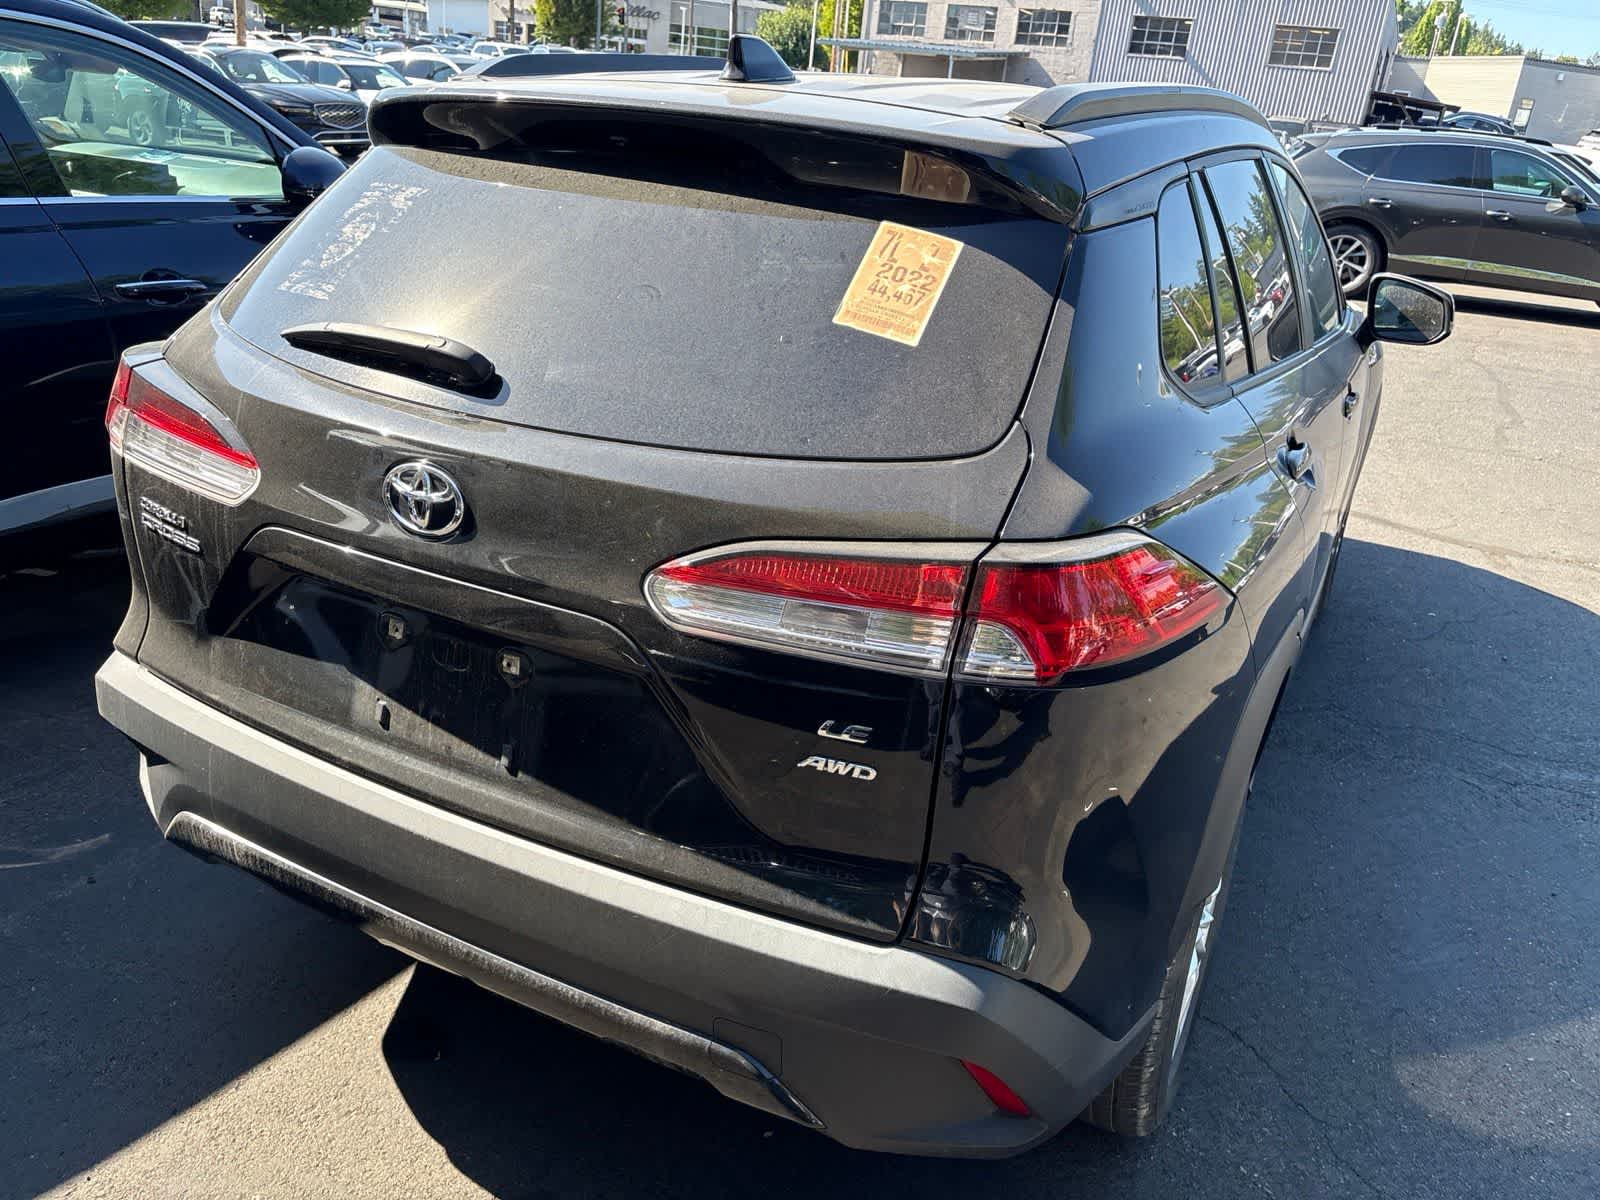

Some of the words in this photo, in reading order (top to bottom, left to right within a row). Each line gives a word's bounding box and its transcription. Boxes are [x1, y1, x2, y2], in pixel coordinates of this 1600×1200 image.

[875, 262, 937, 292] 2022
[141, 512, 201, 552] CROSS
[817, 720, 873, 744] LE
[797, 756, 877, 781] AWD
